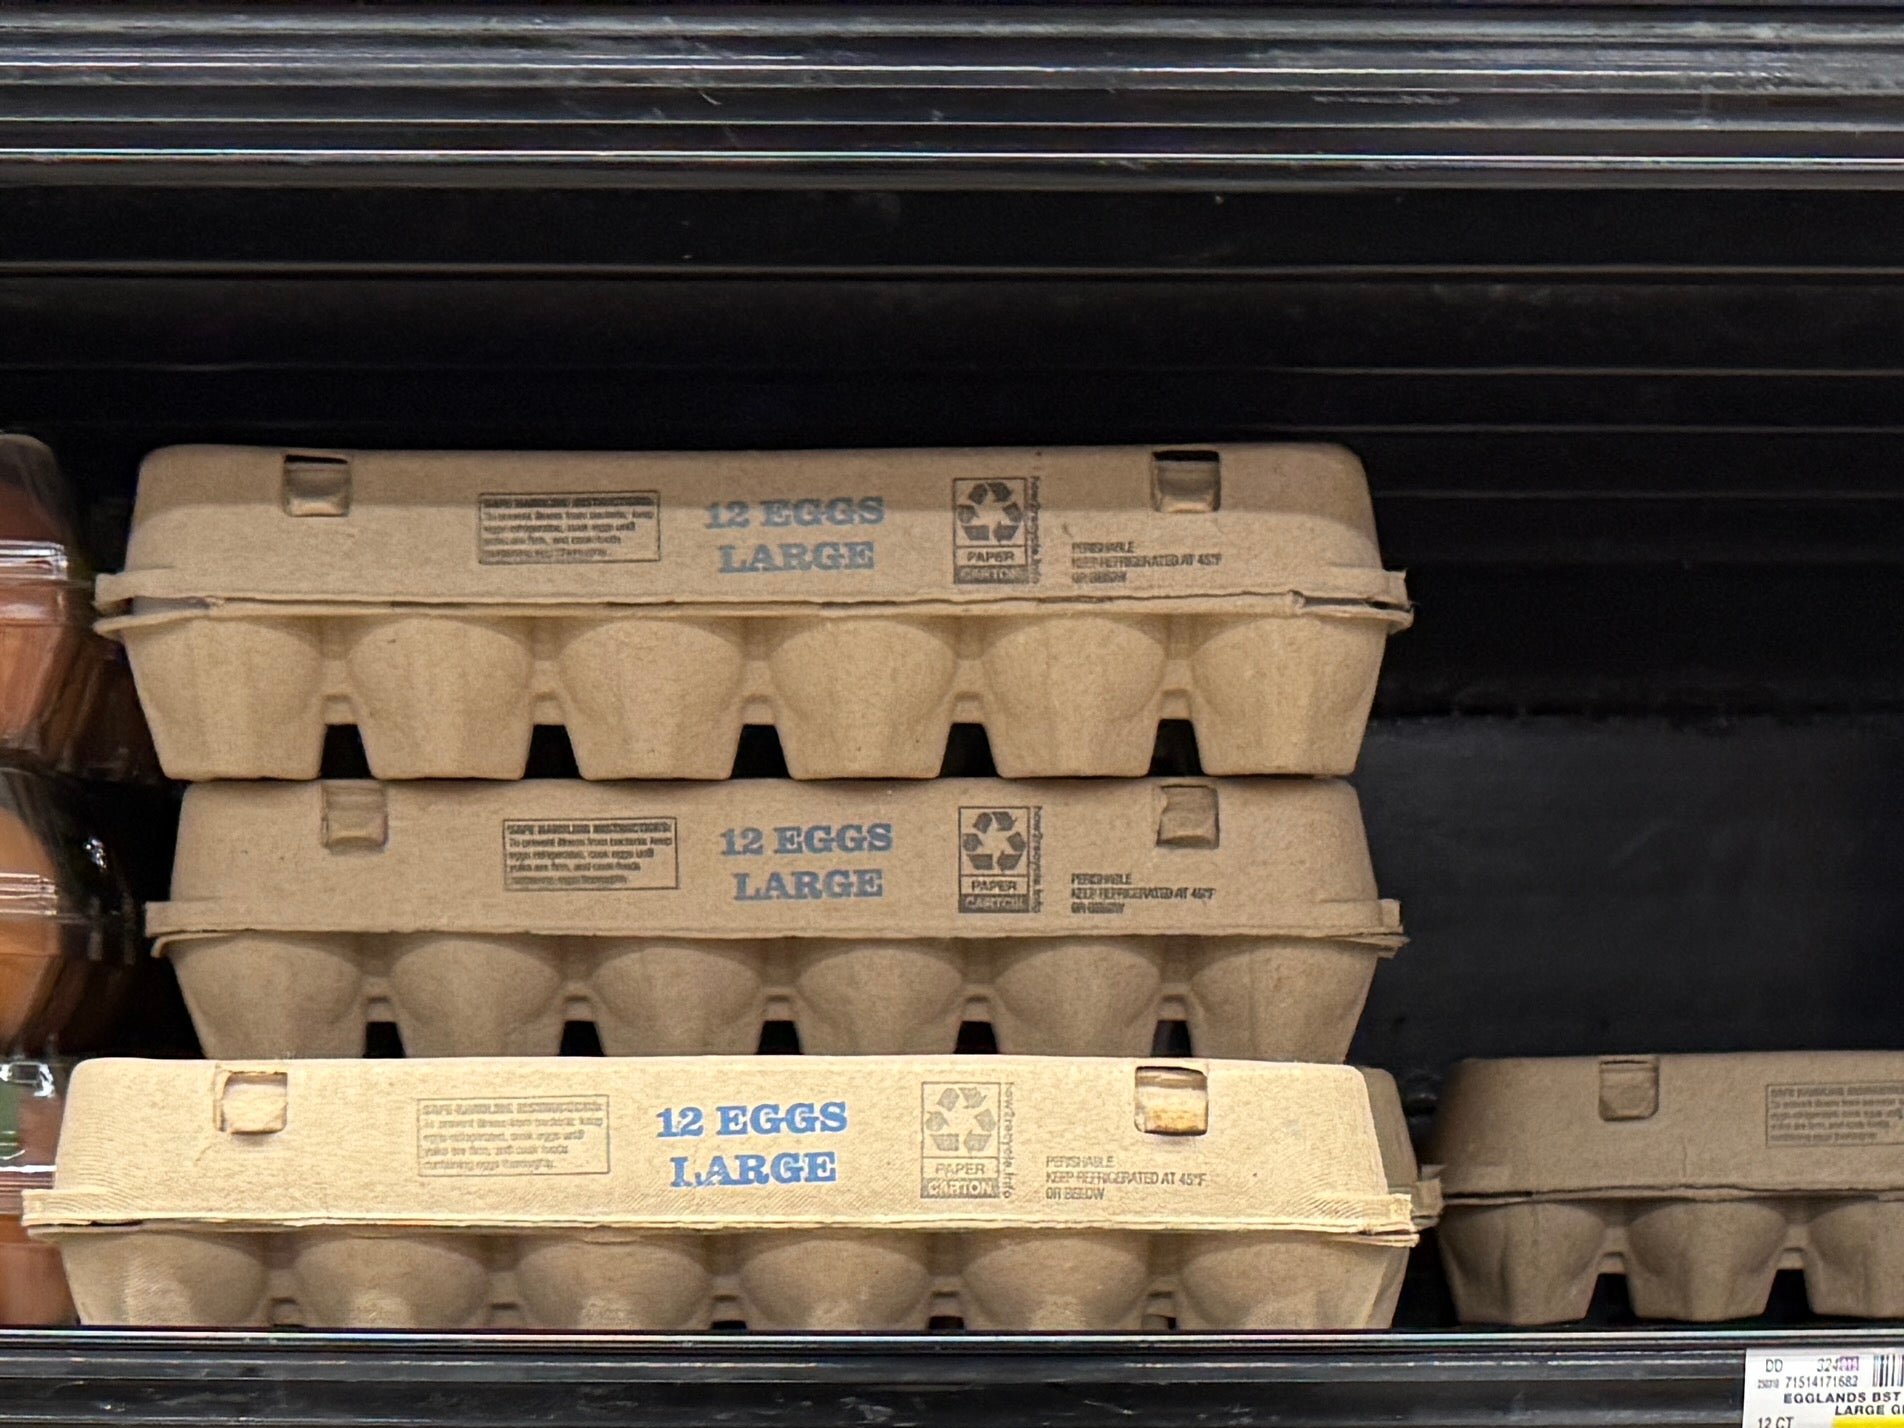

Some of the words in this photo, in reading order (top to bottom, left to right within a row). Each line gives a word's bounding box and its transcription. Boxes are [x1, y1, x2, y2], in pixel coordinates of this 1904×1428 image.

[704, 500, 750, 529] 12
[760, 496, 884, 527] EGGS
[718, 541, 875, 573] LARGE
[968, 550, 1014, 562] PAPER
[720, 828, 763, 855] 12
[773, 823, 893, 854] EGGS
[733, 869, 883, 901] LARGE
[972, 880, 1017, 891] PAPER
[656, 1106, 704, 1138] 12
[715, 1102, 848, 1136] EGGS
[669, 1151, 836, 1188] LARGE
[937, 1162, 985, 1175] PAPER
[1161, 1173, 1177, 1185] AT
[928, 1181, 995, 1196] CARTON
[1834, 1405, 1885, 1416] LARGE
